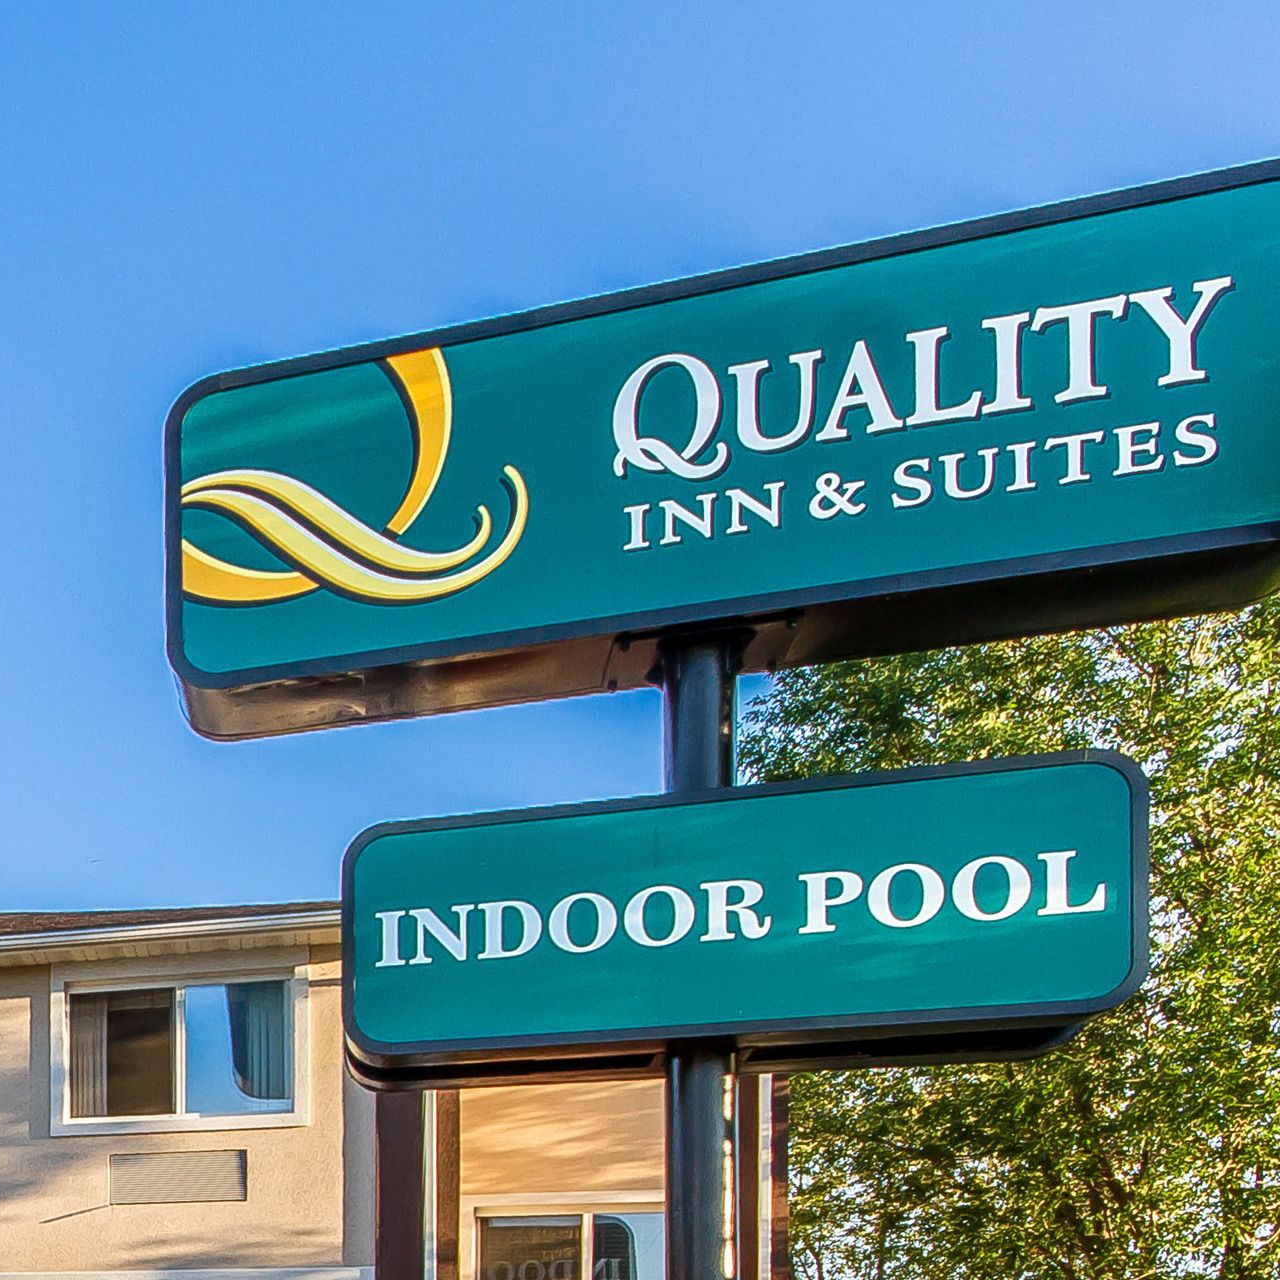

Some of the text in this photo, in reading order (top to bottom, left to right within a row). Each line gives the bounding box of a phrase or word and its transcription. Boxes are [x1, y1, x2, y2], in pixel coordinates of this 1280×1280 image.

[613, 275, 1232, 480] QUALITY
[623, 413, 1218, 551] INN & SUITES
[375, 850, 1107, 968] INDOOR POOL
